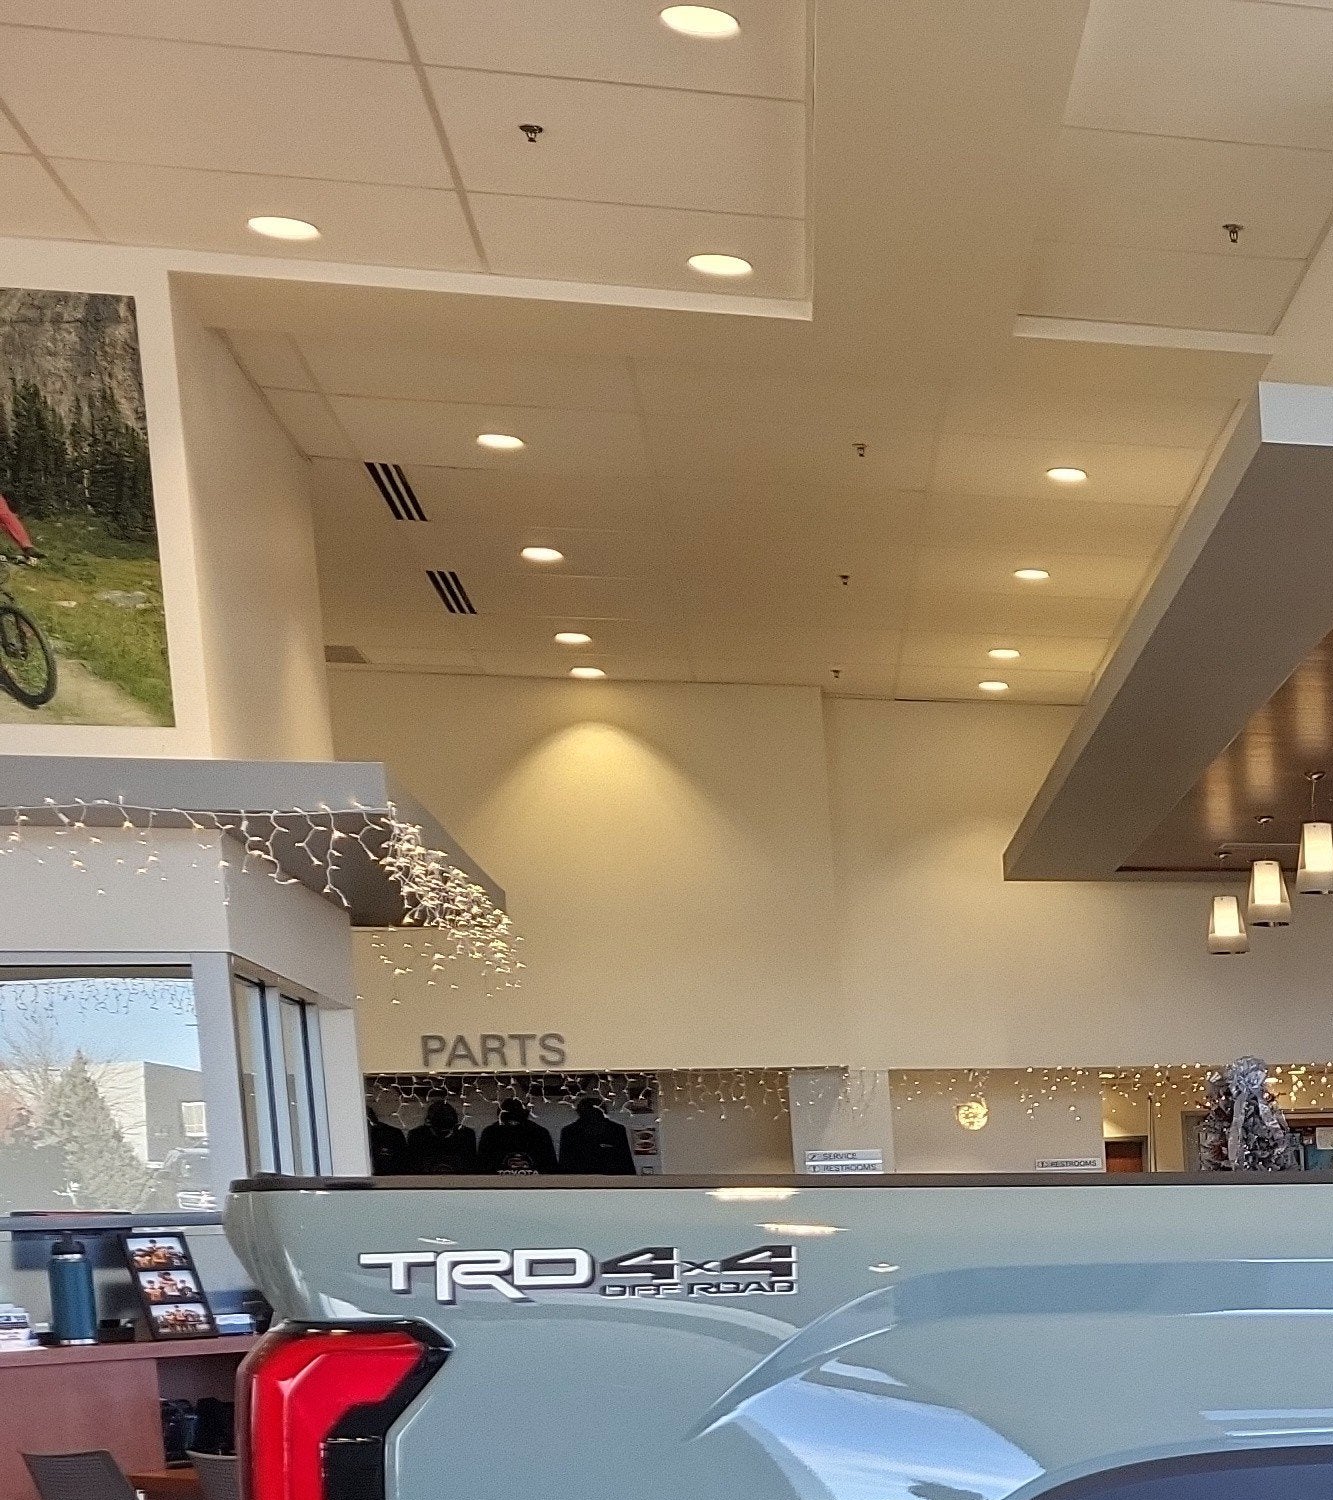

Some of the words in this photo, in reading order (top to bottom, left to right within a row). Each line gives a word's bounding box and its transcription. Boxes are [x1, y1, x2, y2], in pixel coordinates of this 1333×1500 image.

[421, 1033, 565, 1067] PARTS
[823, 1163, 876, 1172] RESTROOMS
[359, 1248, 596, 1305] TRD
[601, 1283, 680, 1298] OFF
[688, 1281, 798, 1297] ROAD
